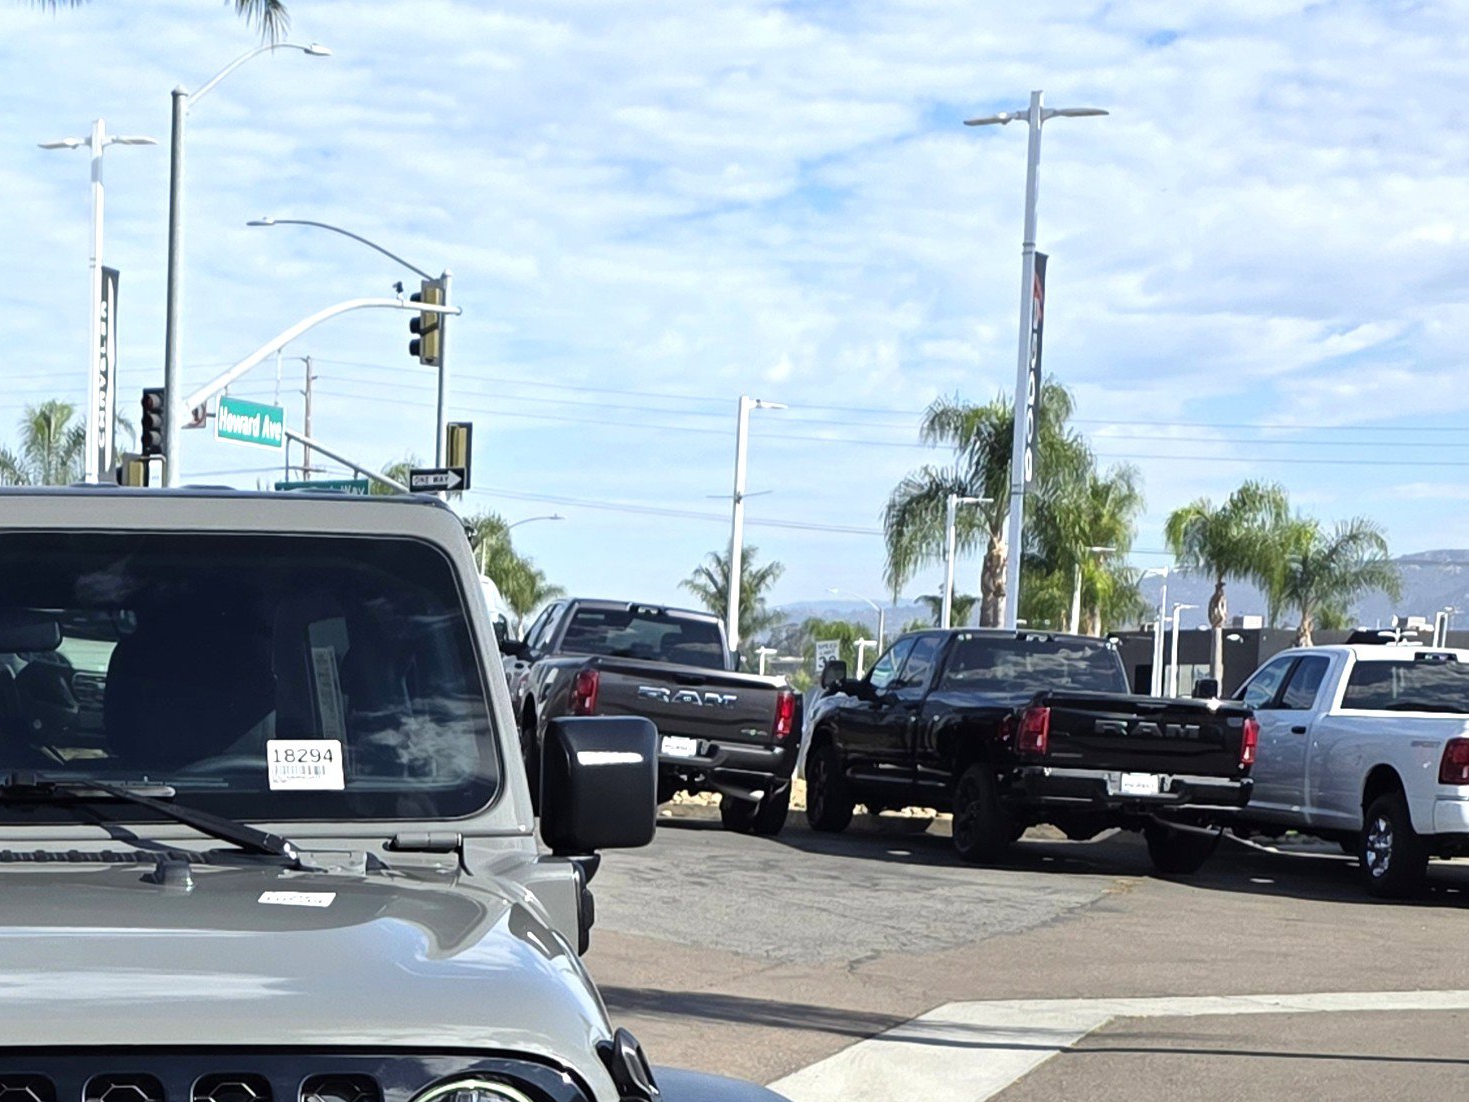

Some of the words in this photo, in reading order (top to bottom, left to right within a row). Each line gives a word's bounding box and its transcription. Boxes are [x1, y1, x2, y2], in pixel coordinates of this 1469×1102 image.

[218, 405, 261, 438] Howard
[262, 414, 282, 441] Ave
[413, 476, 429, 485] ONE
[432, 475, 449, 484] WAY
[637, 685, 738, 708] RAM
[1094, 719, 1200, 739] RAM
[273, 748, 333, 763] 18294
